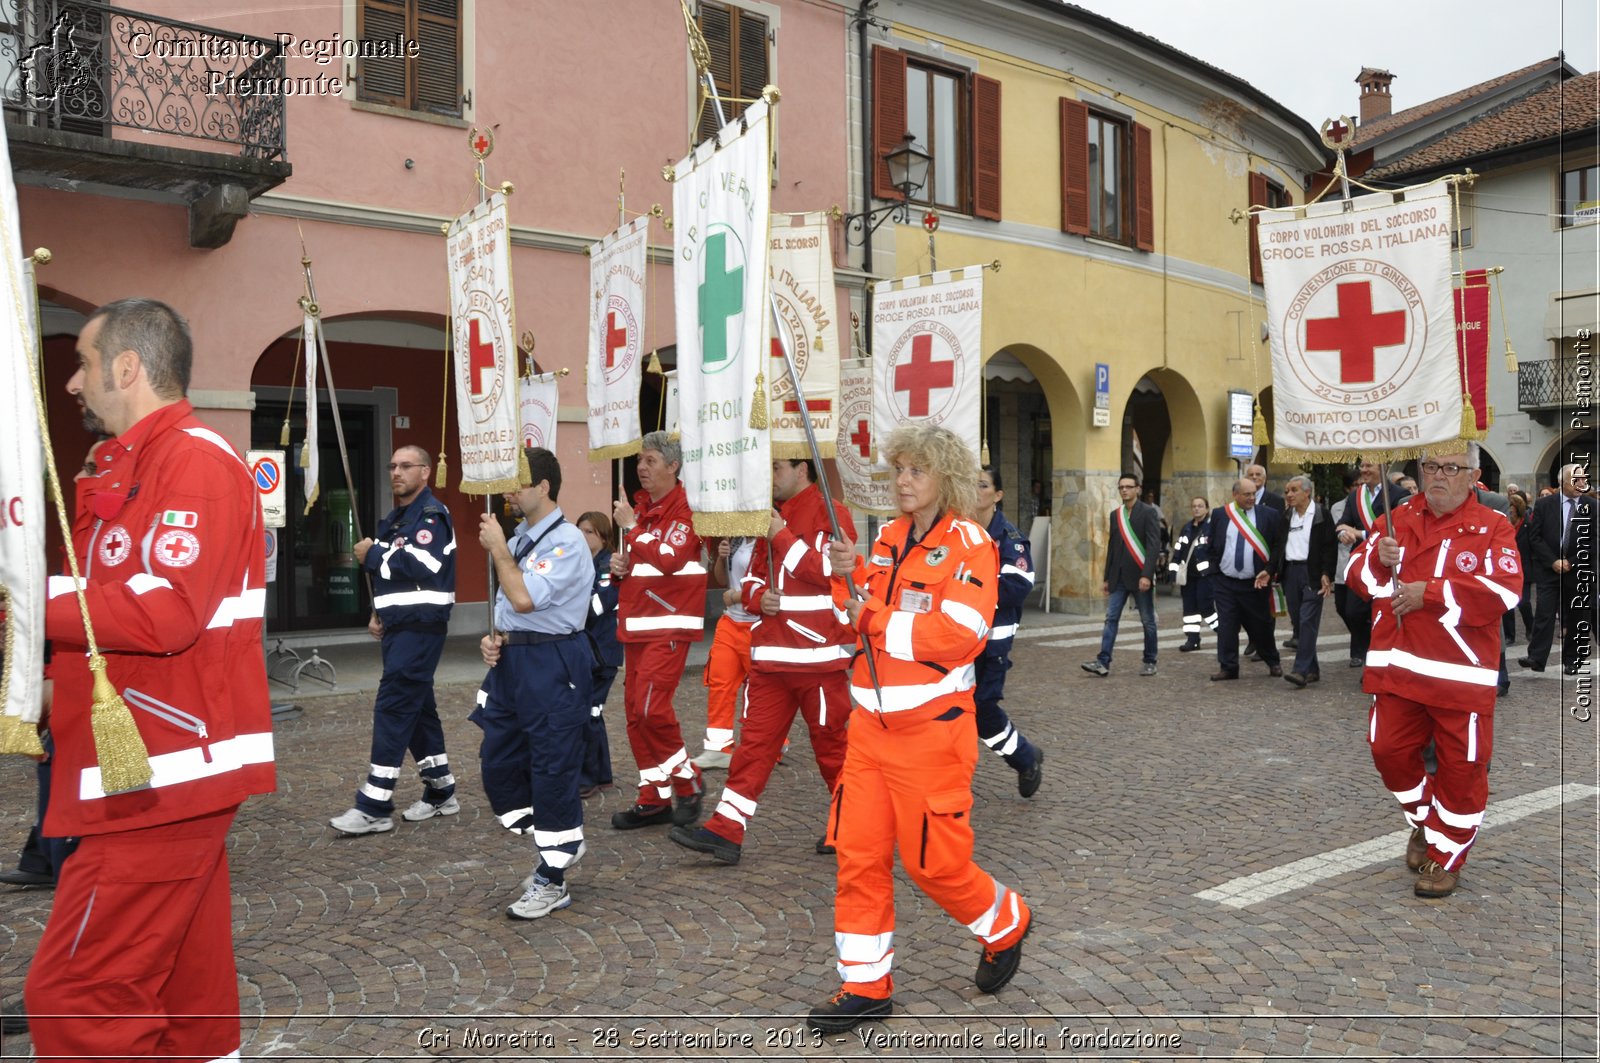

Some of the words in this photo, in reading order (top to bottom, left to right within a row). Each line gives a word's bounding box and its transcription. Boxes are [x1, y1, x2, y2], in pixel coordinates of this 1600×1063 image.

[1269, 230, 1300, 243] CORPO
[1304, 223, 1354, 240] VOLONTARI
[1361, 219, 1382, 233] DEL
[1386, 207, 1437, 229] SOCCORSO
[1262, 246, 1315, 261] CROCE
[1320, 238, 1373, 257] ROSSA
[1378, 223, 1450, 249] ITALIANA
[779, 269, 830, 332] ITALIANA
[879, 300, 896, 311] CORPO
[899, 294, 928, 309] VOLONTARI
[931, 293, 942, 304] DEL
[945, 287, 975, 302] SOCCORSO
[1289, 262, 1357, 321] CONVENZIONE
[1364, 263, 1377, 273] DI
[1381, 266, 1420, 310] GINEVRA
[790, 315, 800, 330] 22
[874, 311, 904, 323] CROCE
[907, 307, 936, 321] ROSSA
[938, 301, 980, 316] ITALIANA
[794, 333, 805, 376] AGOST
[887, 322, 926, 367] CONVENZIONE
[929, 322, 938, 331] DI
[939, 327, 962, 361] GINEVRA
[1098, 366, 1107, 390] P
[842, 386, 871, 402] ROSSA
[1285, 410, 1352, 425] COMITATO
[1359, 404, 1418, 423] LOCALE
[1424, 400, 1440, 415] DI
[1305, 424, 1420, 446] RACCONIGI
